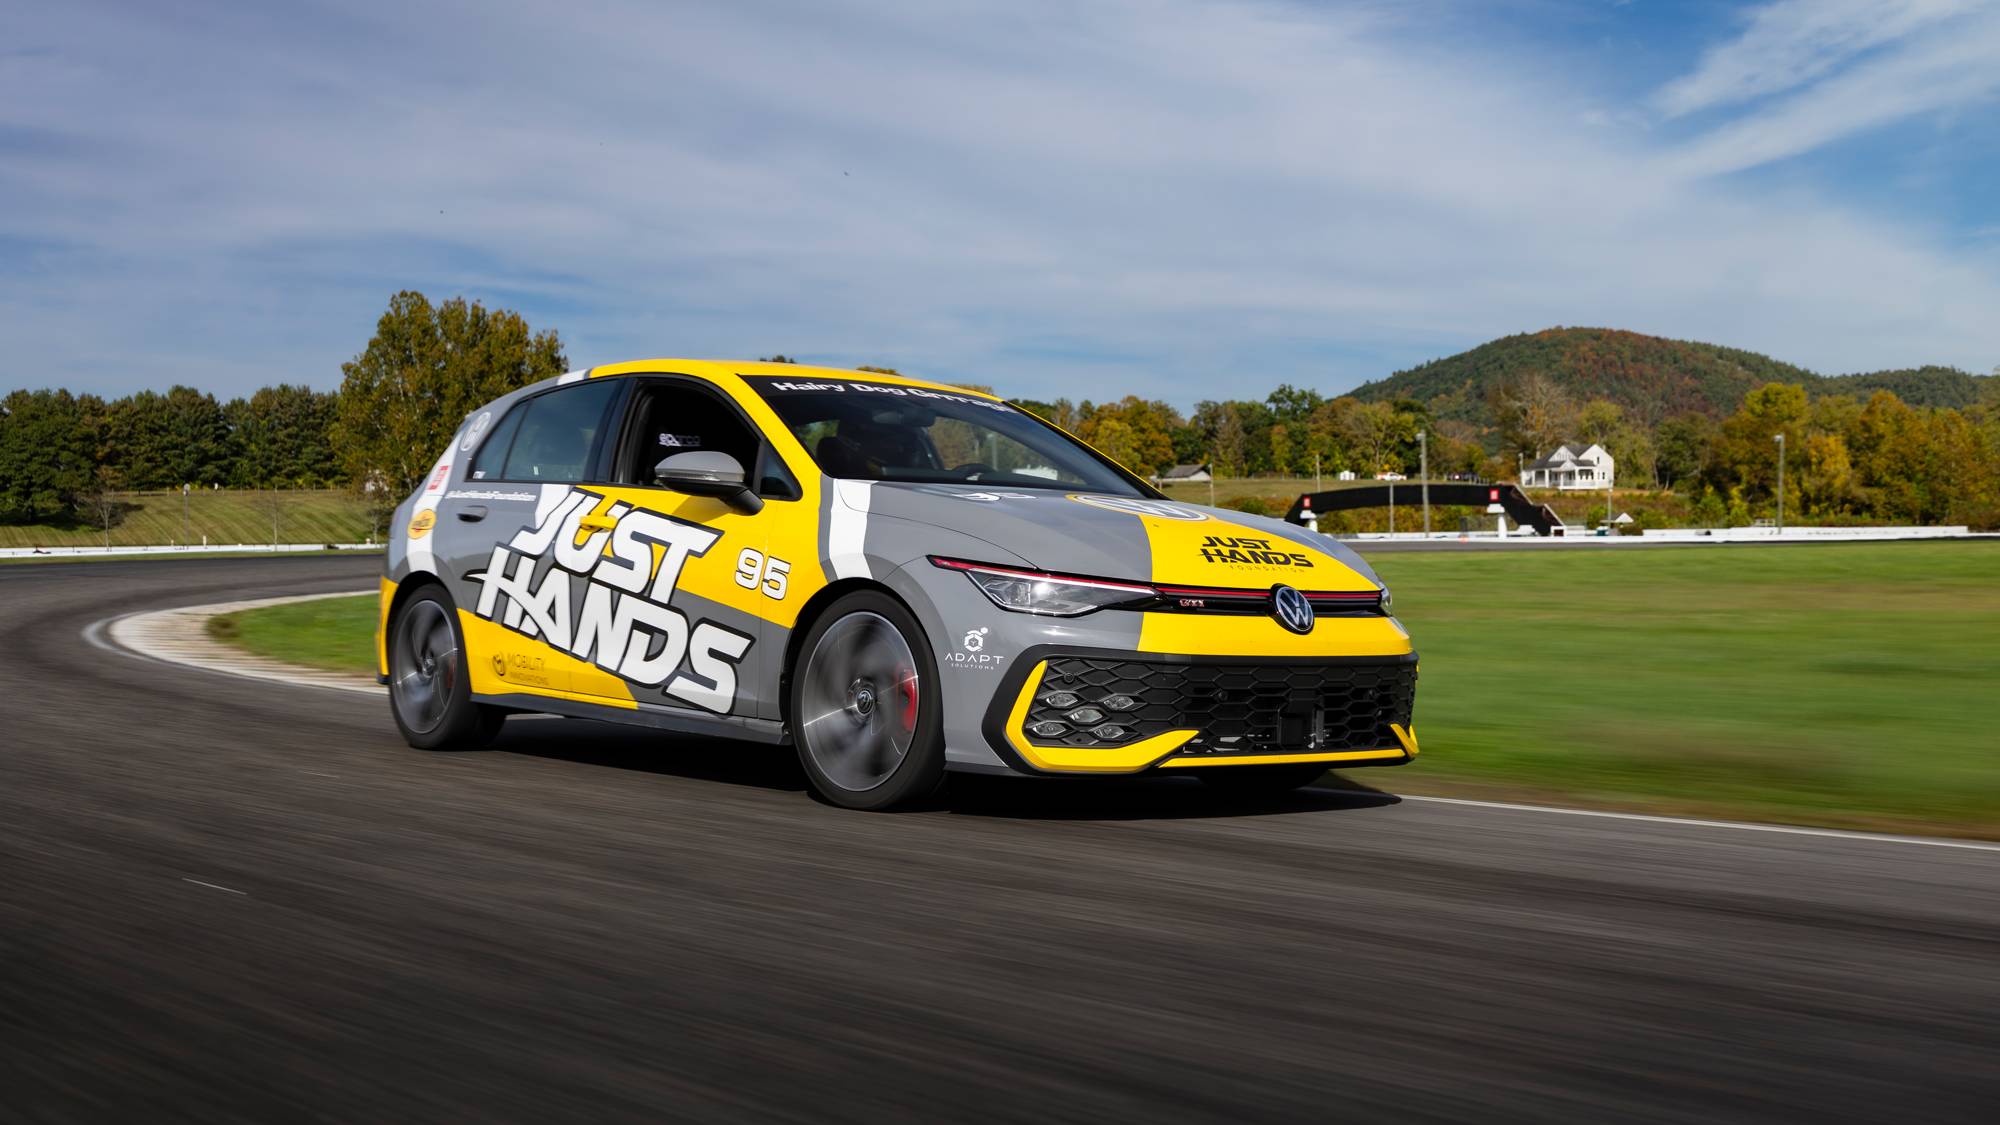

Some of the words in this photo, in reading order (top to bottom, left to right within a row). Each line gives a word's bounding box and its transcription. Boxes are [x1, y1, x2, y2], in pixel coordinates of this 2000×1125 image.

[771, 382, 845, 392] Hairy
[849, 383, 907, 396] Dog
[507, 486, 724, 606] JUST
[1202, 536, 1272, 550] JUST
[1199, 548, 1314, 568] HANDS
[734, 547, 792, 600] 95
[461, 542, 755, 719] HANDS
[944, 652, 1004, 665] ADAPT
